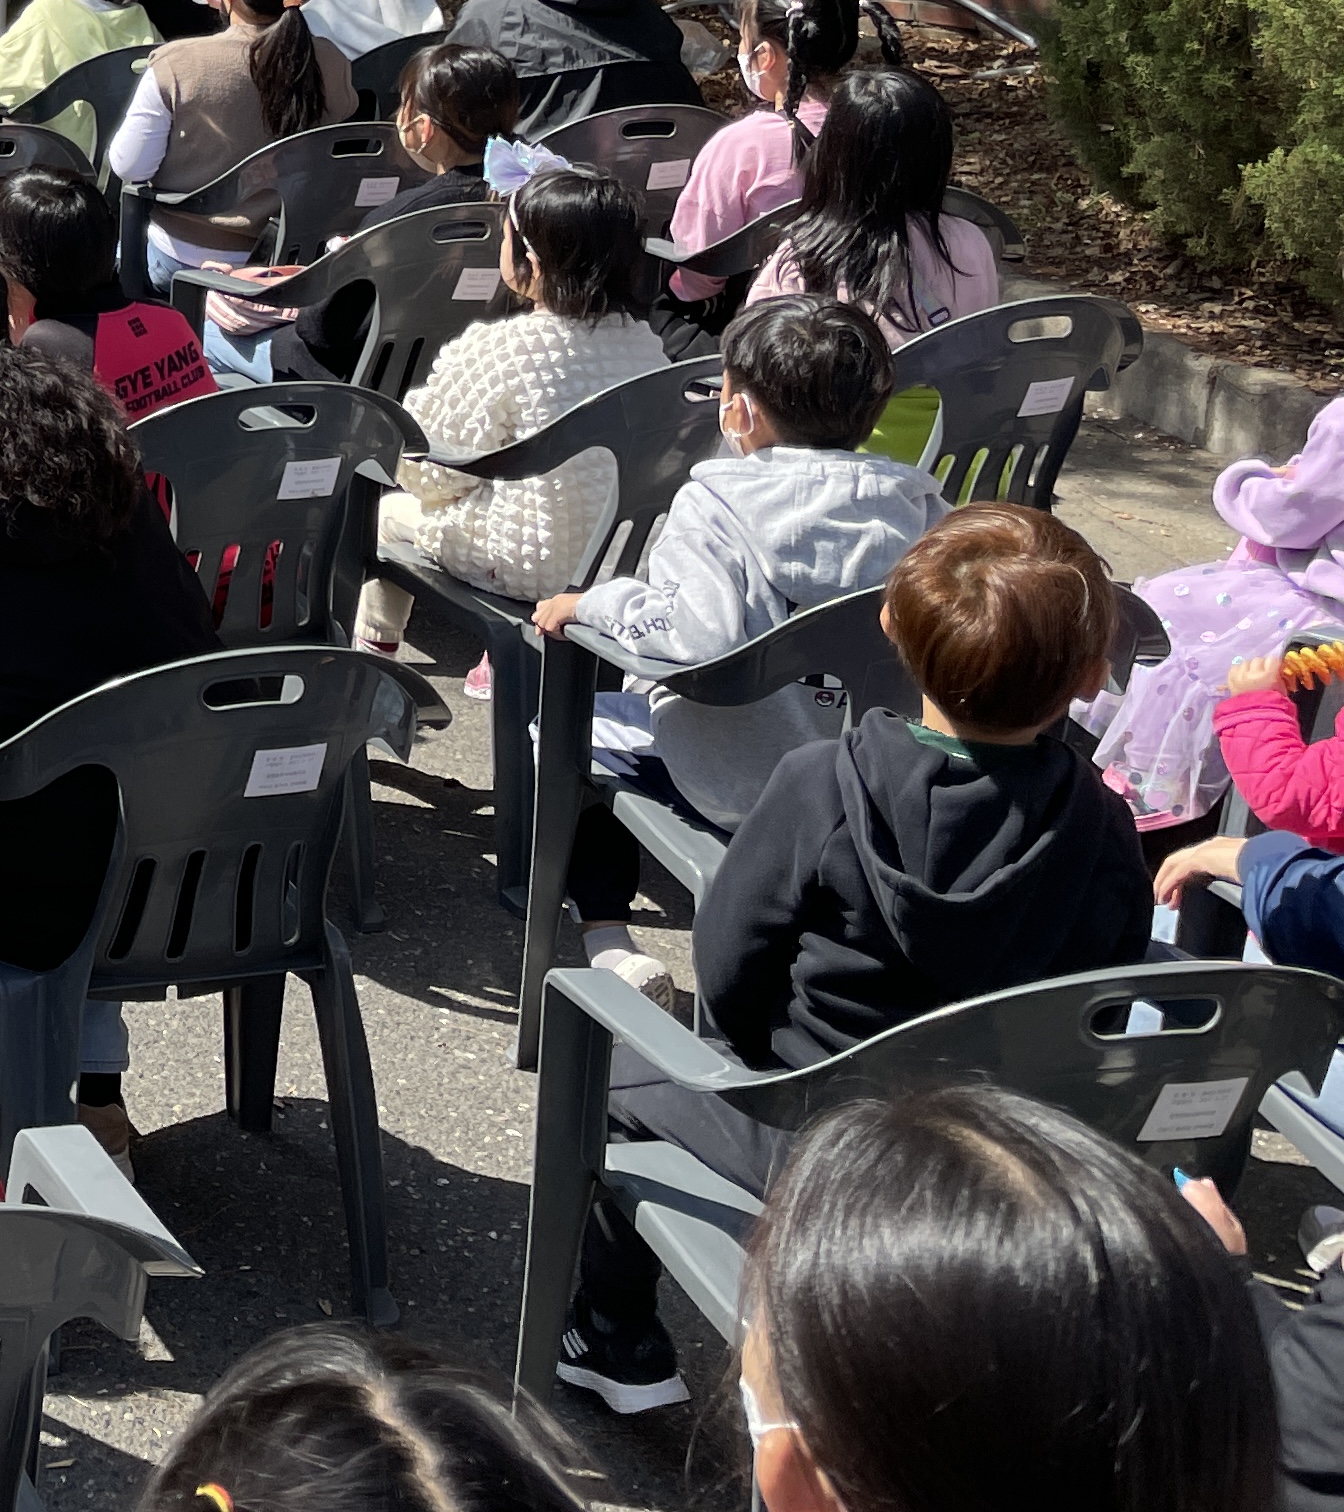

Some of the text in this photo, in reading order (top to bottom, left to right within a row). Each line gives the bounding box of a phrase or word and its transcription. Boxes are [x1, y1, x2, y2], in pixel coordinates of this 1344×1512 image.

[114, 340, 202, 401] GYE YANG
[125, 364, 205, 413] FOOTBALL CLUB
